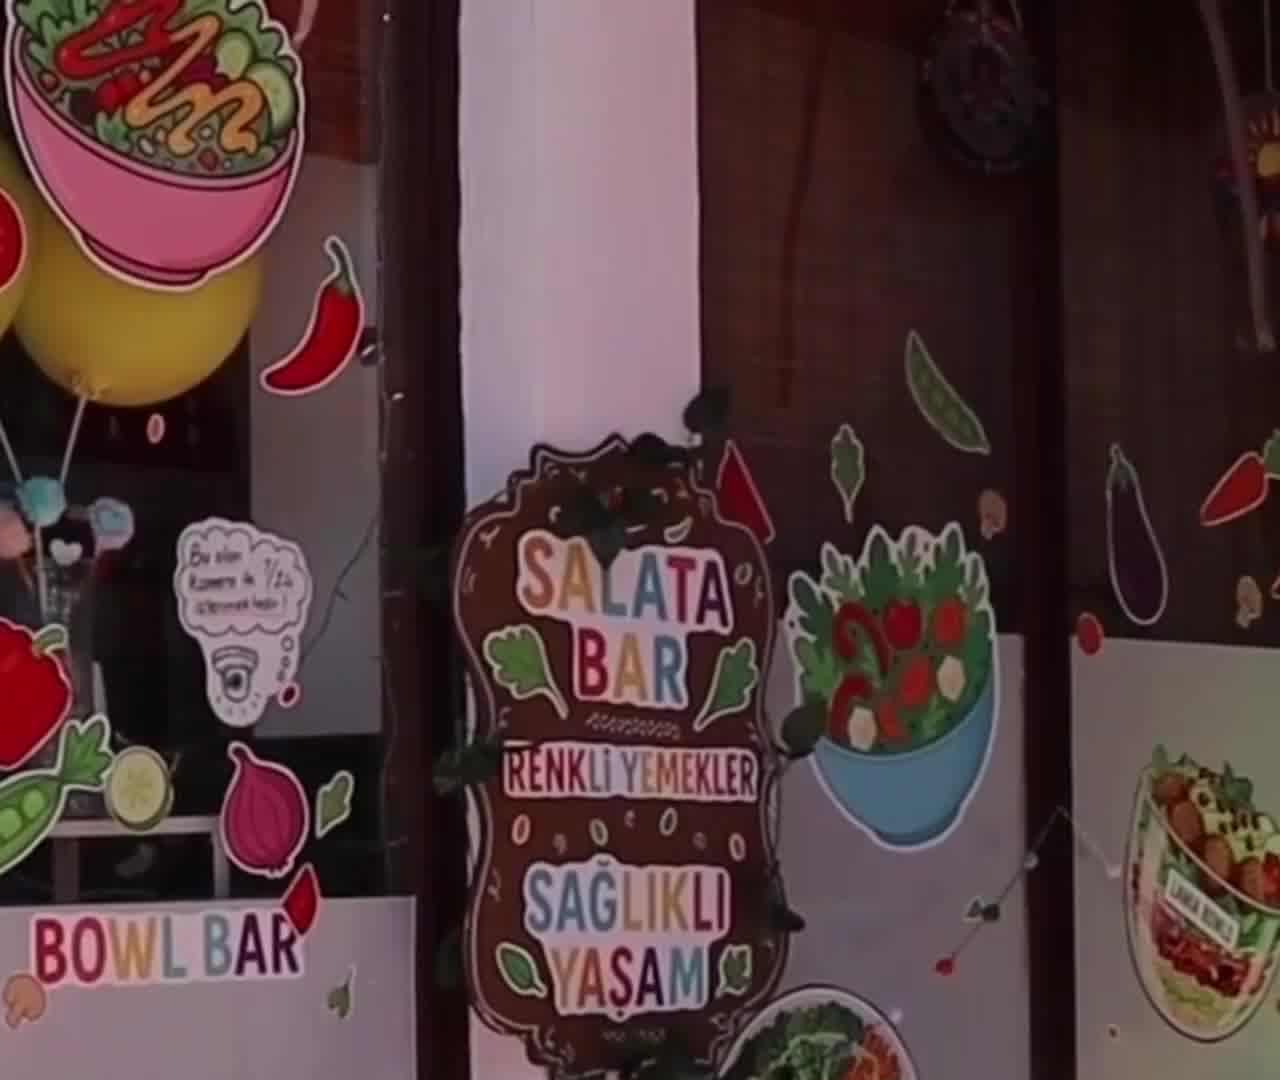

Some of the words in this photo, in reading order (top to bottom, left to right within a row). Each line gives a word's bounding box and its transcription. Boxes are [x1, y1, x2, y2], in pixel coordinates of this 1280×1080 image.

[522, 536, 730, 627] SALATA
[578, 627, 684, 702] BAR
[620, 752, 756, 797] YEMEKLER
[528, 859, 725, 932] SAĞLIKLI
[35, 916, 187, 984] BOWL
[204, 912, 299, 976] BAR
[550, 946, 704, 1017] YAŞAM
